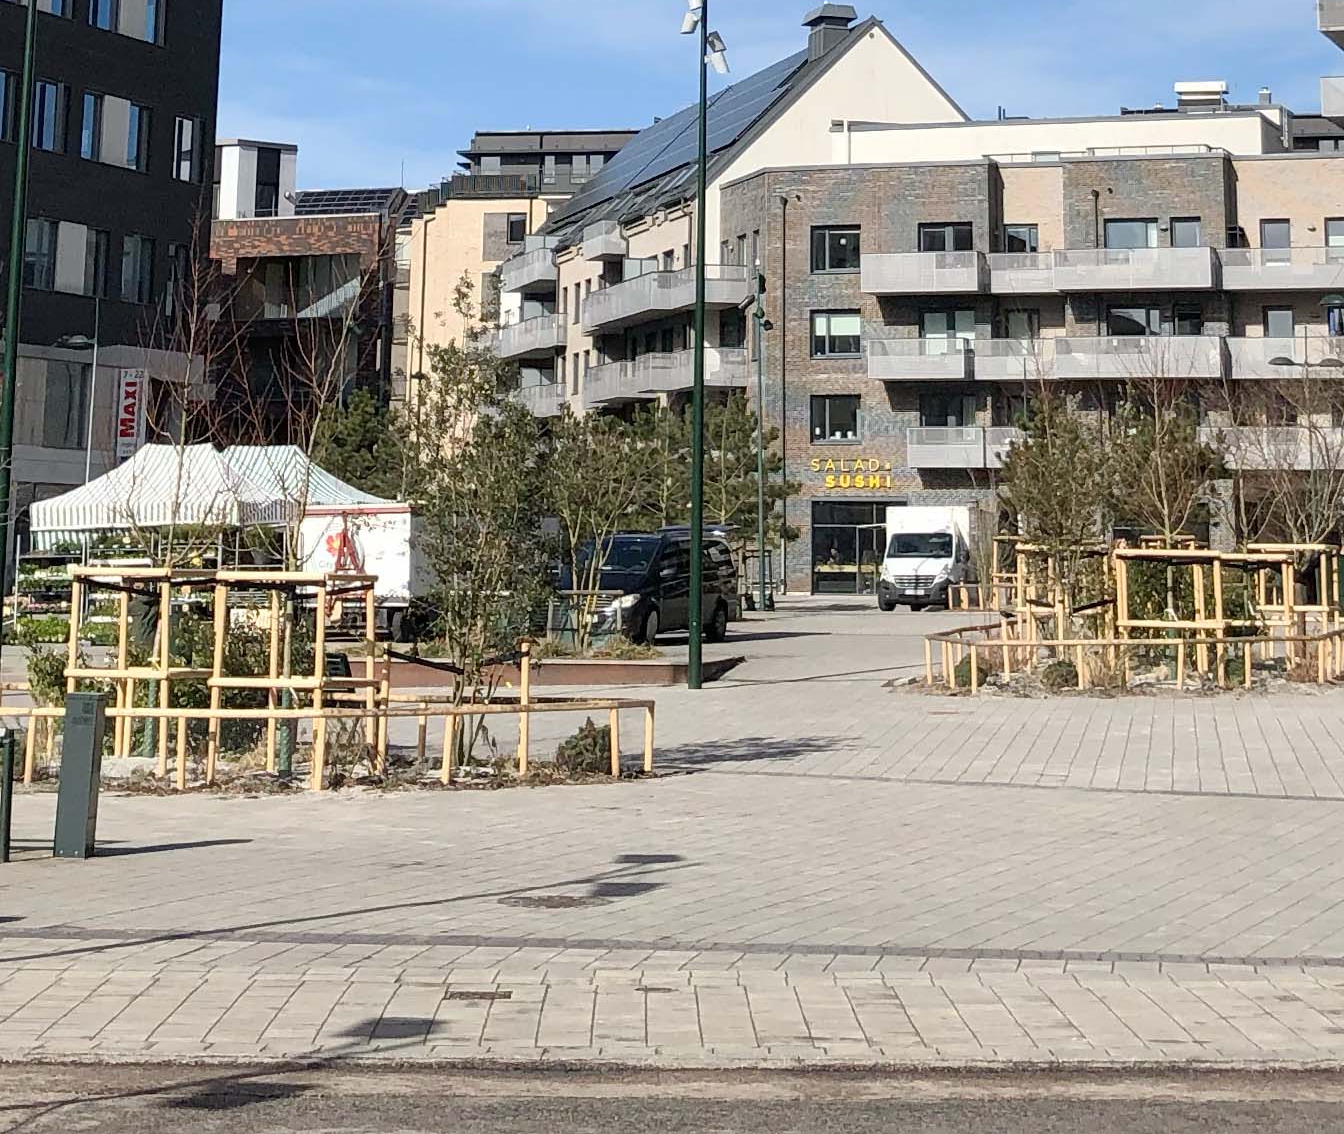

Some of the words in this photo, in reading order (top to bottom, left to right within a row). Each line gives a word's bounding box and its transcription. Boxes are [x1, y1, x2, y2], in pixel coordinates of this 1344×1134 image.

[120, 382, 137, 437] MAXI
[811, 458, 880, 472] SALAD
[825, 474, 891, 488] SUSHI
